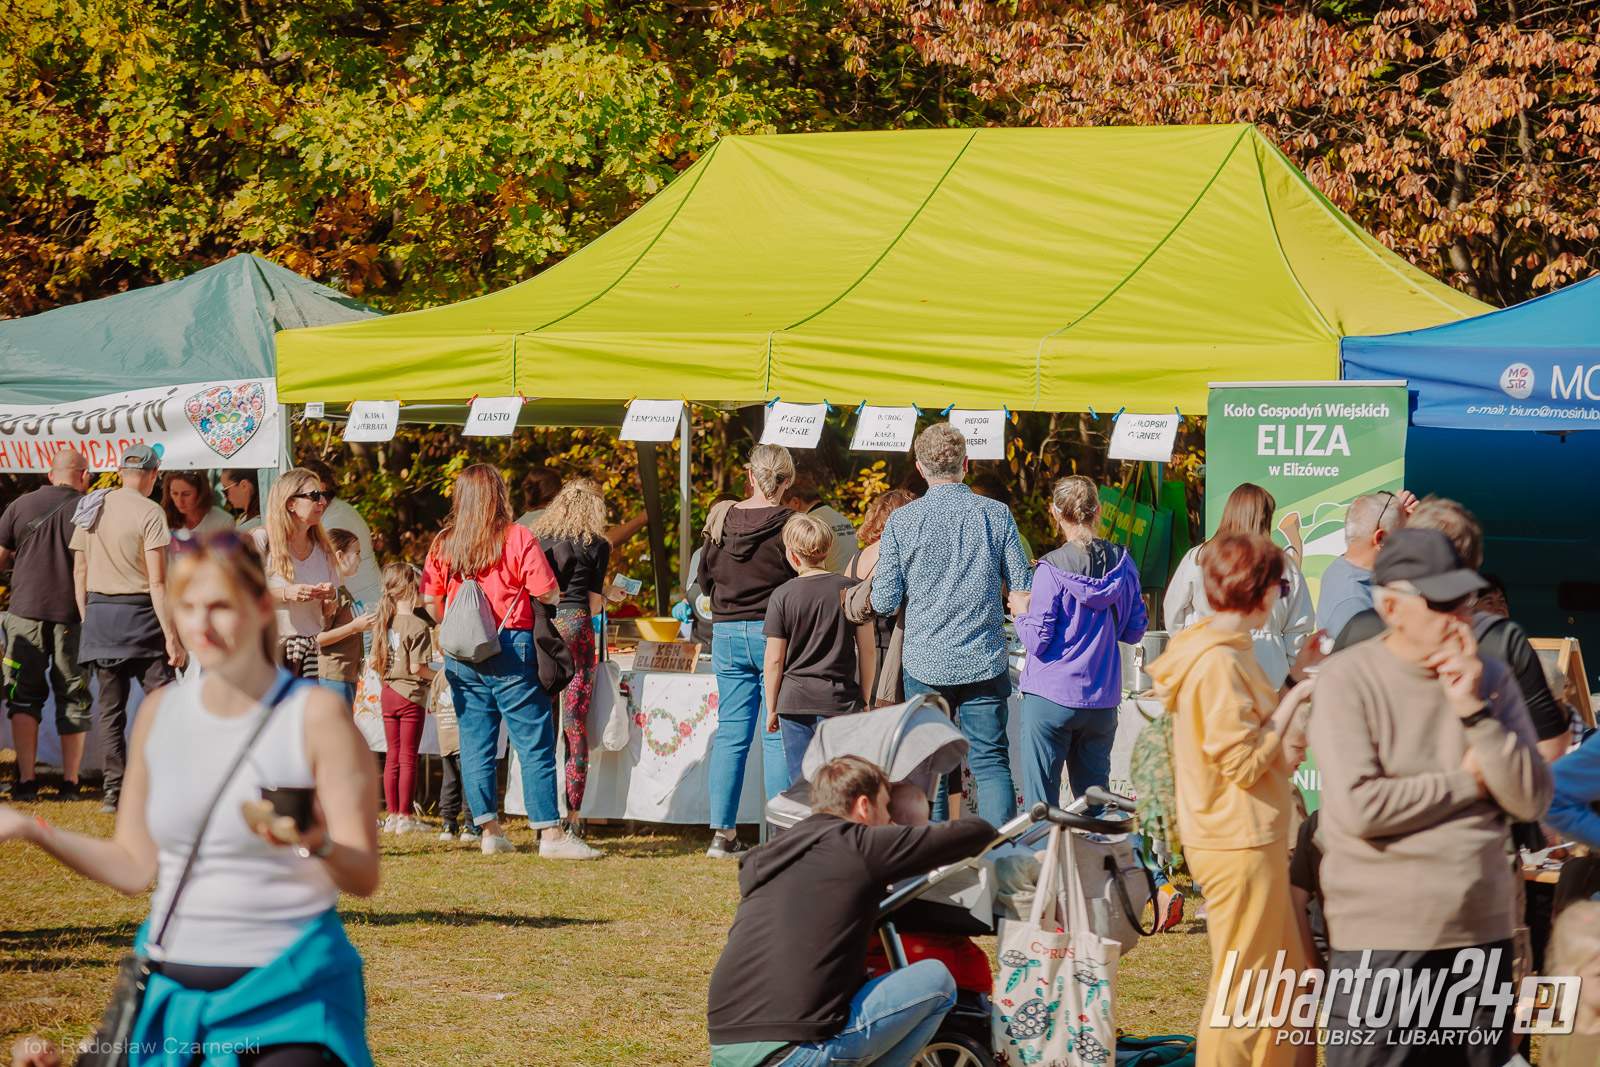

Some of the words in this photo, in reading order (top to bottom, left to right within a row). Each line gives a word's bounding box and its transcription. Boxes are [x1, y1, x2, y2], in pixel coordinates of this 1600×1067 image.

[477, 412, 510, 421] CIASTO
[631, 415, 675, 423] LEMONIADA
[1224, 403, 1256, 417] Koło
[1258, 403, 1322, 420] Gospodyń
[1325, 403, 1390, 420] Wiejskich
[1466, 404, 1506, 415] e-mail:
[1509, 405, 1600, 420] biuro@mosirlub
[964, 417, 990, 425] PIEROGI
[1257, 424, 1352, 457] ELIZA
[1268, 465, 1281, 476] w
[1283, 462, 1339, 477] Elizówce
